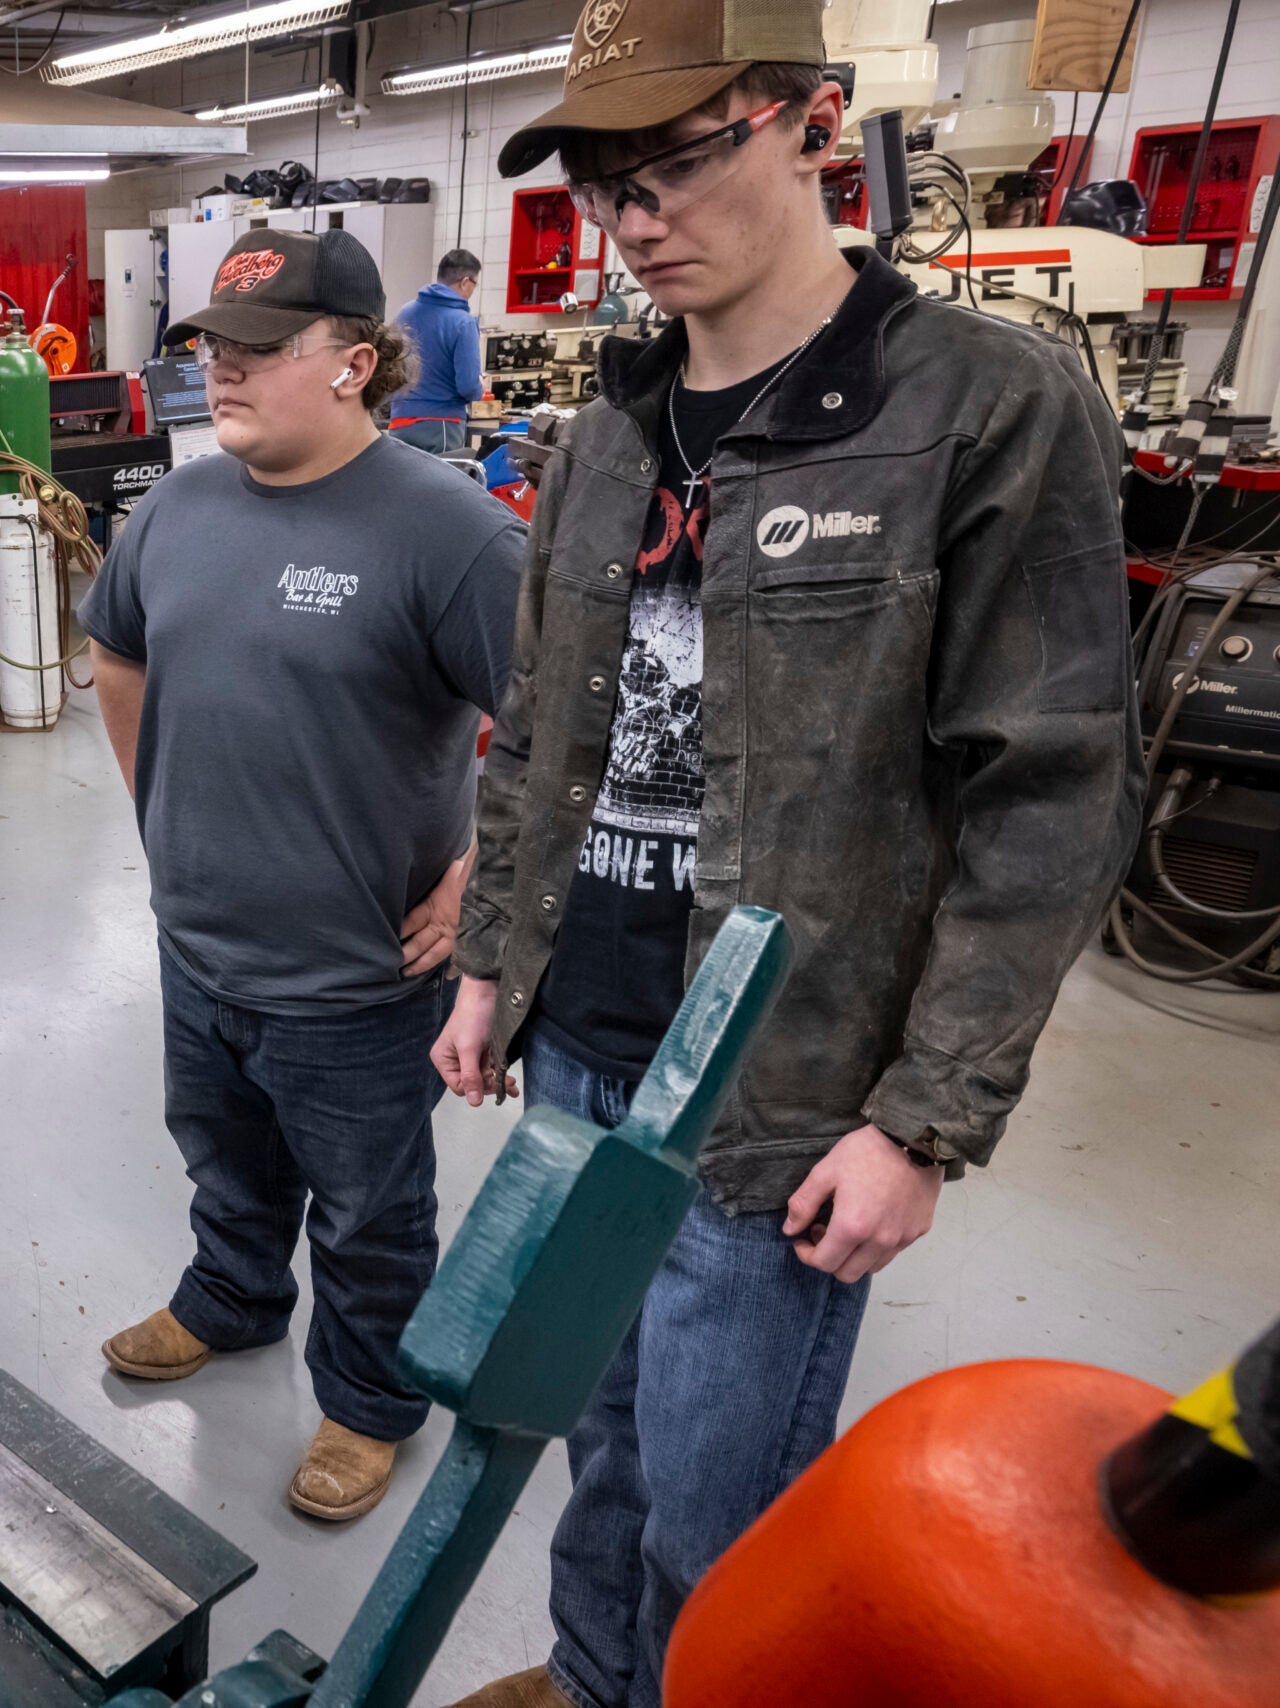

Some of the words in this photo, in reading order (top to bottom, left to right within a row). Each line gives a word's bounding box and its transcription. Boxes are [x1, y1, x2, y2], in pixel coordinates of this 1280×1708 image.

[567, 37, 643, 83] ARIAT
[235, 275, 260, 292] 3
[926, 265, 1072, 303] JET
[113, 464, 165, 482] 4400
[113, 480, 160, 491] TORCHMAT
[812, 511, 880, 539] Miller
[277, 563, 359, 596] Antlers
[285, 589, 304, 602] Bar
[304, 593, 313, 603] &
[315, 592, 344, 608] Grill
[1200, 680, 1238, 694] Miller
[1225, 704, 1280, 719] Millermatic
[578, 825, 659, 890] GONE
